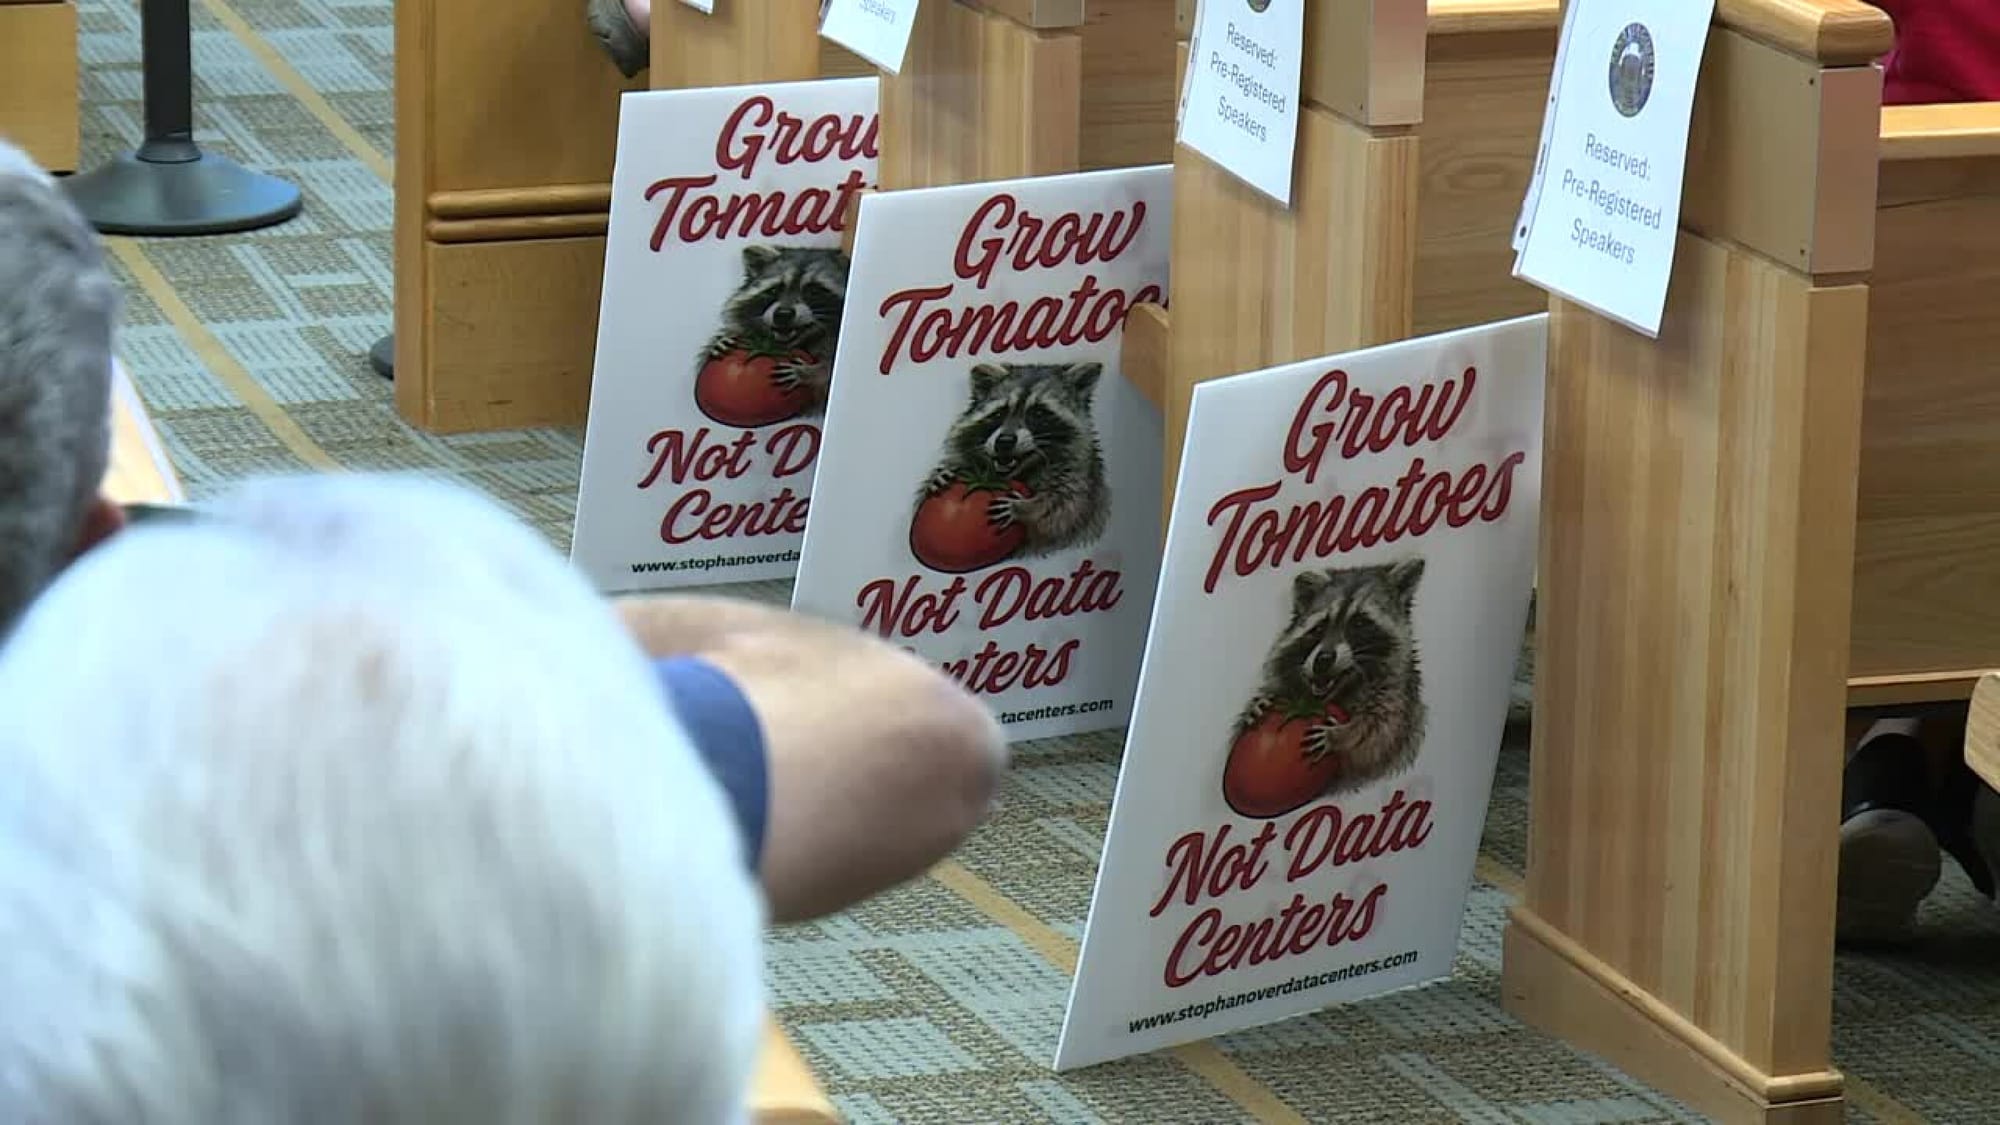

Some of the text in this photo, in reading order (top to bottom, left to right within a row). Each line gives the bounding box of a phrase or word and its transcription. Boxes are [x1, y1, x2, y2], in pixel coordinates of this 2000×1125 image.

[1227, 21, 1277, 70] Reserved:
[1211, 51, 1286, 113] Pre-Registered
[1218, 96, 1267, 142] Speakers
[1585, 132, 1651, 181] Reserved:
[645, 170, 878, 252] Tomat
[1562, 168, 1661, 230] Pre-Registered
[953, 193, 1146, 289] Grow
[1571, 217, 1635, 264] Speakers
[879, 275, 1169, 375] Tomato
[1283, 366, 1476, 484] Grow
[637, 427, 757, 489] Not
[660, 487, 811, 545] Cente
[1203, 451, 1525, 594] Tomatoes
[631, 549, 801, 573] www.stophanoverda
[857, 559, 1124, 639] Not Data
[902, 638, 1080, 695] ters
[1149, 790, 1434, 918] Not Data
[1163, 883, 1388, 988] Centers
[1128, 949, 1418, 1033] www.stophanoverdatacenters.com
